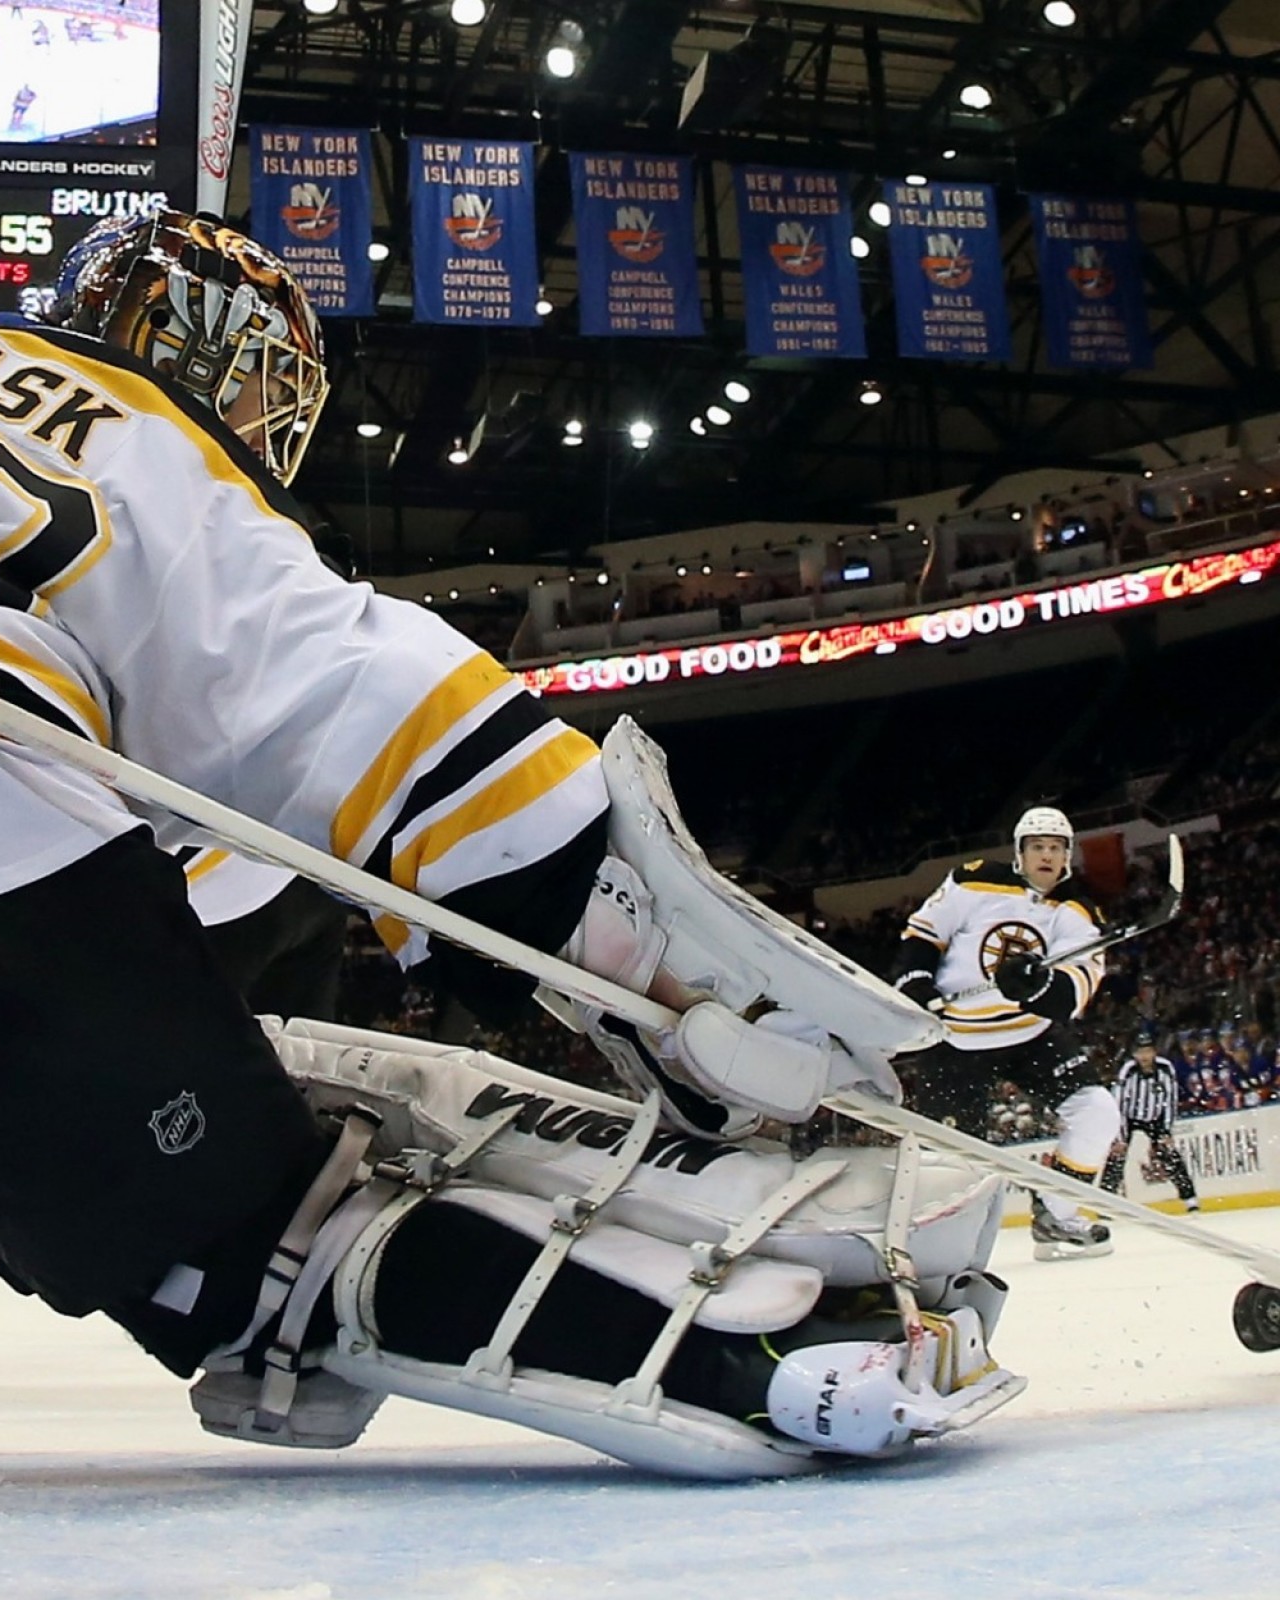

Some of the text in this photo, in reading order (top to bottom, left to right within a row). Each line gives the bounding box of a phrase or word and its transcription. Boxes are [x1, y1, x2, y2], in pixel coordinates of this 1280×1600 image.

[200, 0, 240, 182] Coors LIGH
[261, 134, 358, 153] NEW YORK
[423, 144, 519, 164] NEW YORK
[73, 161, 152, 176] HOCKEY
[263, 157, 358, 177] ISLANDERS
[424, 165, 520, 186] ISLANDERS
[585, 158, 678, 179] NEW YORK
[587, 180, 680, 200] ISLANDERS
[745, 173, 837, 193] NEW YORK
[51, 188, 169, 216] BRUINS
[749, 195, 840, 215] ISLANDERS
[895, 186, 985, 207] NEW YORK
[899, 210, 987, 229] ISLANDERS
[283, 246, 340, 260] CAMPBELL
[285, 262, 346, 276] ONFERENCE
[447, 258, 505, 272] CAMPBELL
[442, 273, 511, 288] CONFERENCE
[443, 289, 511, 303] CHAMPIONS
[608, 301, 675, 315] CHAMPIONS
[567, 654, 670, 691] GOOD
[680, 640, 781, 678] FOOD
[921, 601, 1024, 643] GOOD
[1035, 574, 1149, 620] TIMES
[1178, 1128, 1263, 1178] ANADIAN
